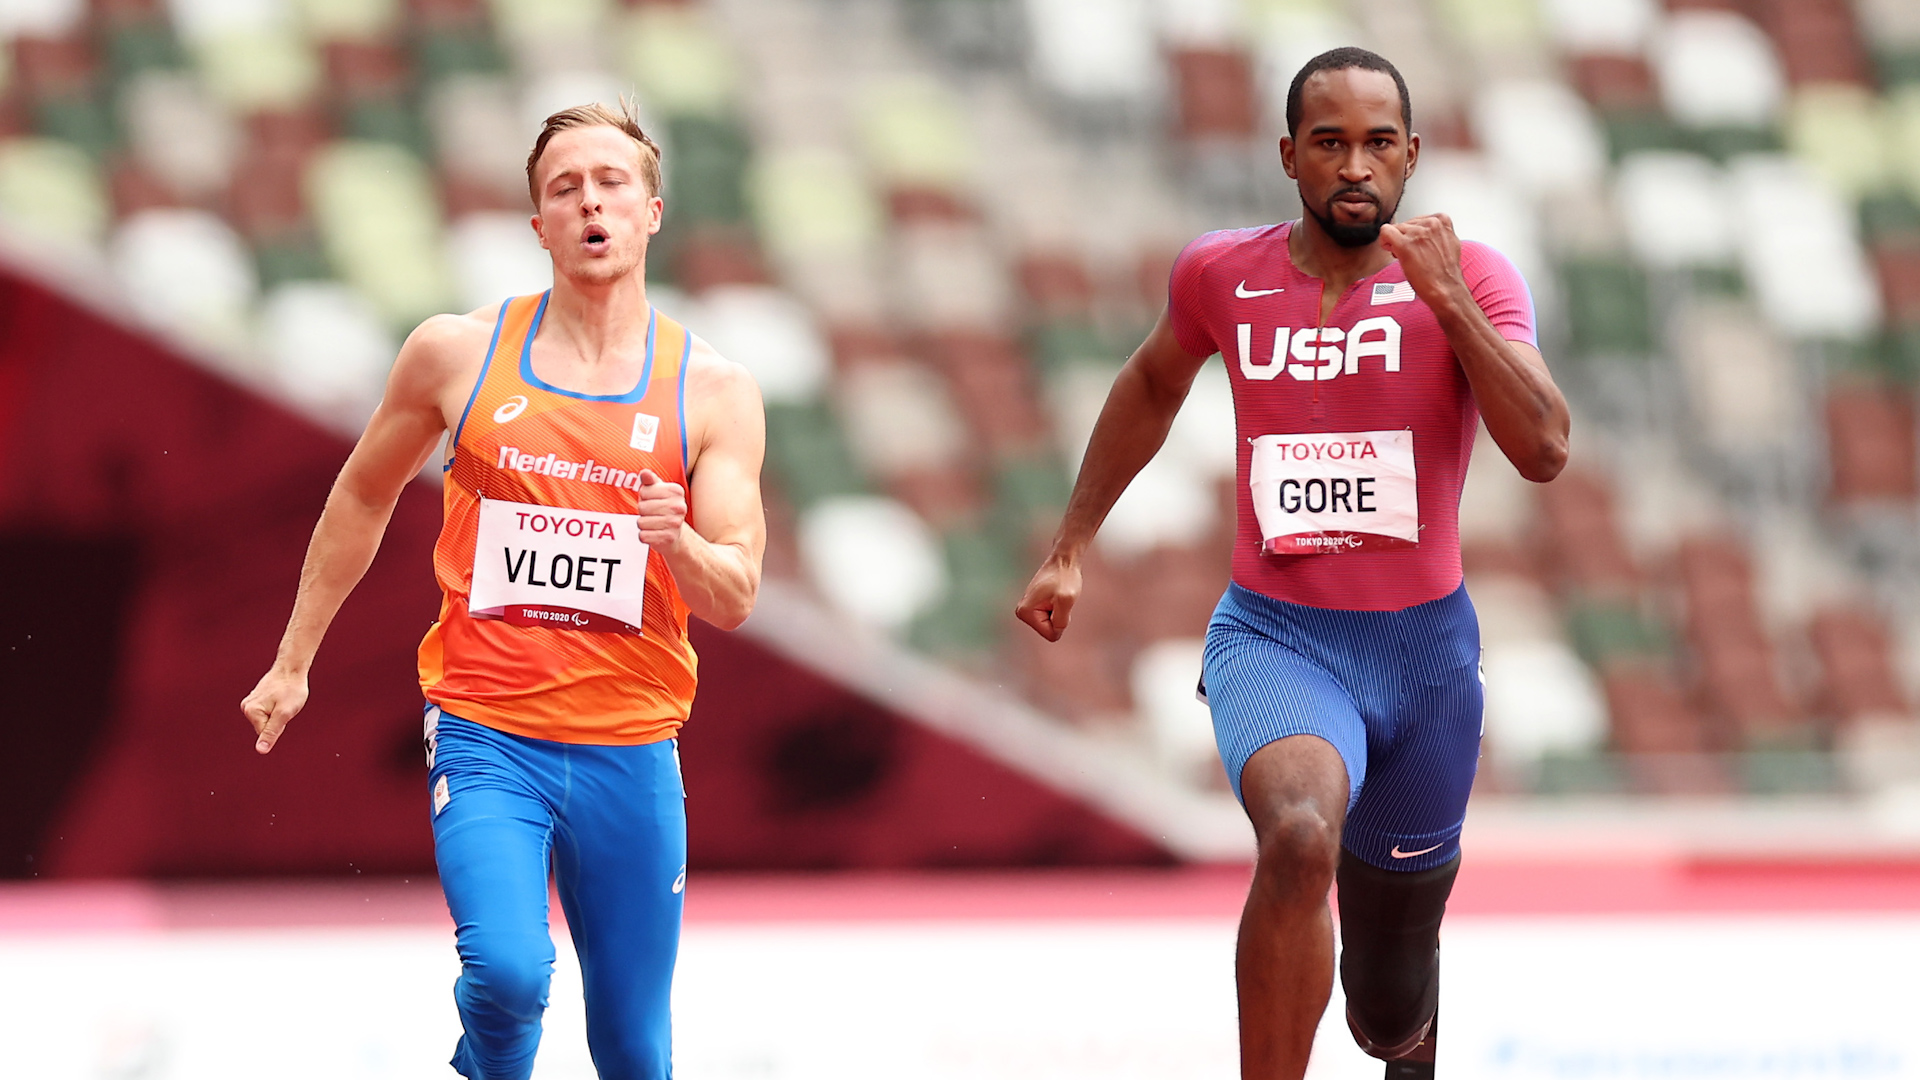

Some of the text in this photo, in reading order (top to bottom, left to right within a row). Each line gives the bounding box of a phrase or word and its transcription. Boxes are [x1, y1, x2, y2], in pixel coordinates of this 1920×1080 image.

[1237, 315, 1402, 381] USA
[1277, 441, 1378, 461] TOYOTA
[1279, 477, 1377, 513] GORE
[516, 512, 616, 540] TOYOTA
[1295, 537, 1343, 546] TOKYO 2020
[504, 547, 621, 593] VLOET
[522, 608, 570, 622] TOKYO 2020
